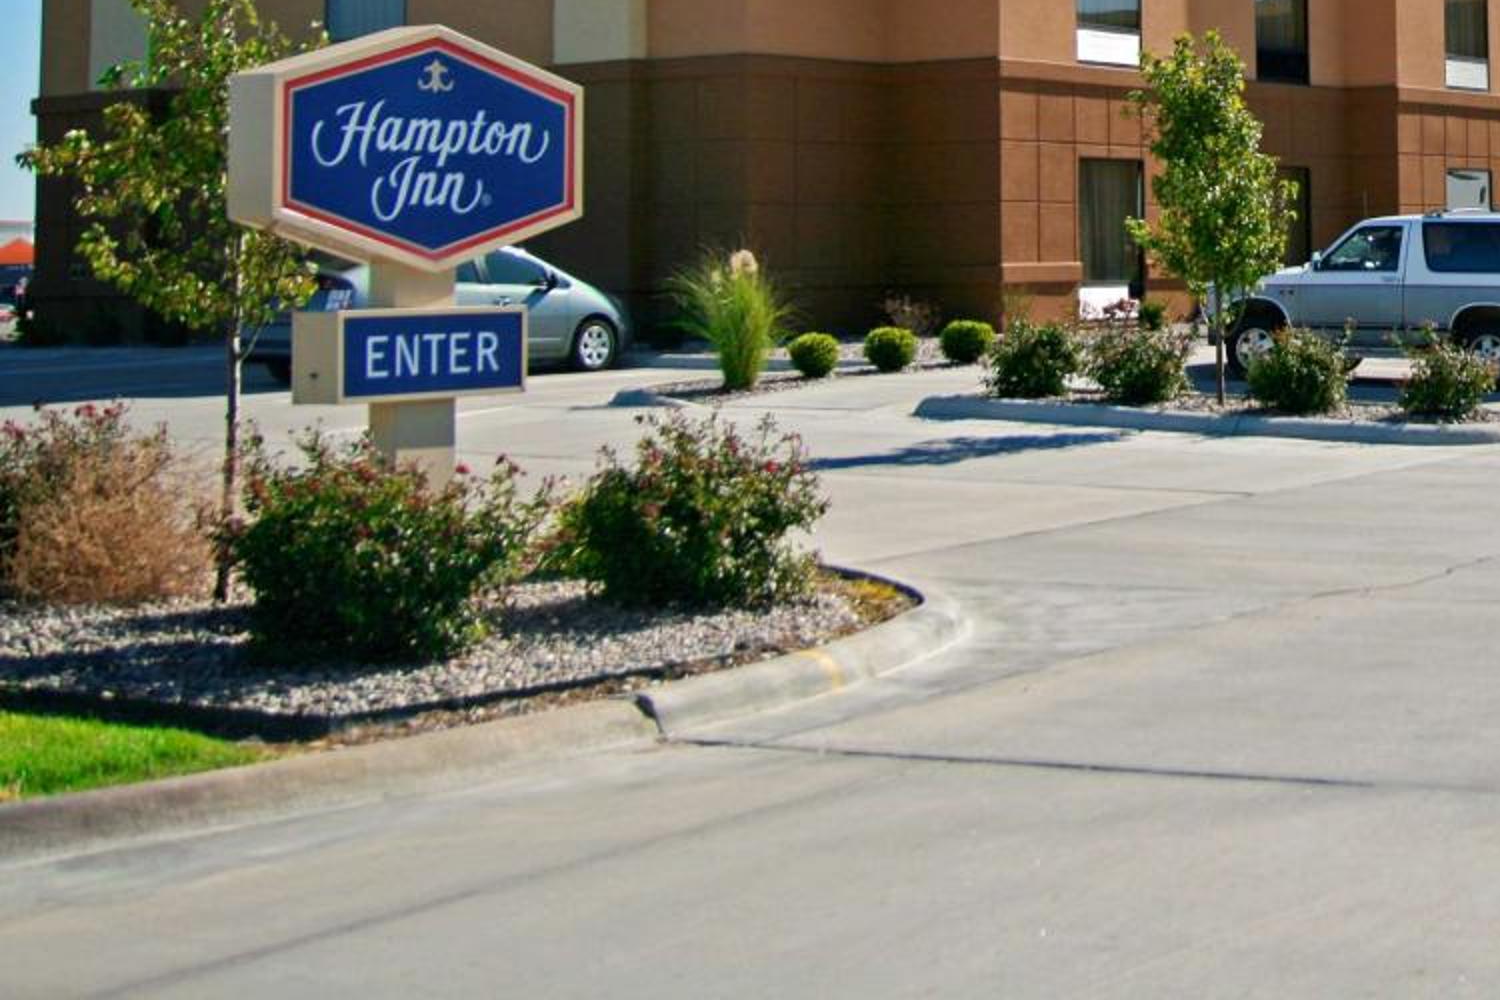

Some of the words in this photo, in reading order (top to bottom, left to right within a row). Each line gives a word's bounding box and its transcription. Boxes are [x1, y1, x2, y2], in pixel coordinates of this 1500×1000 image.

[311, 99, 549, 167] Hampton
[371, 155, 483, 222] Inn
[365, 331, 500, 379] ENTER
